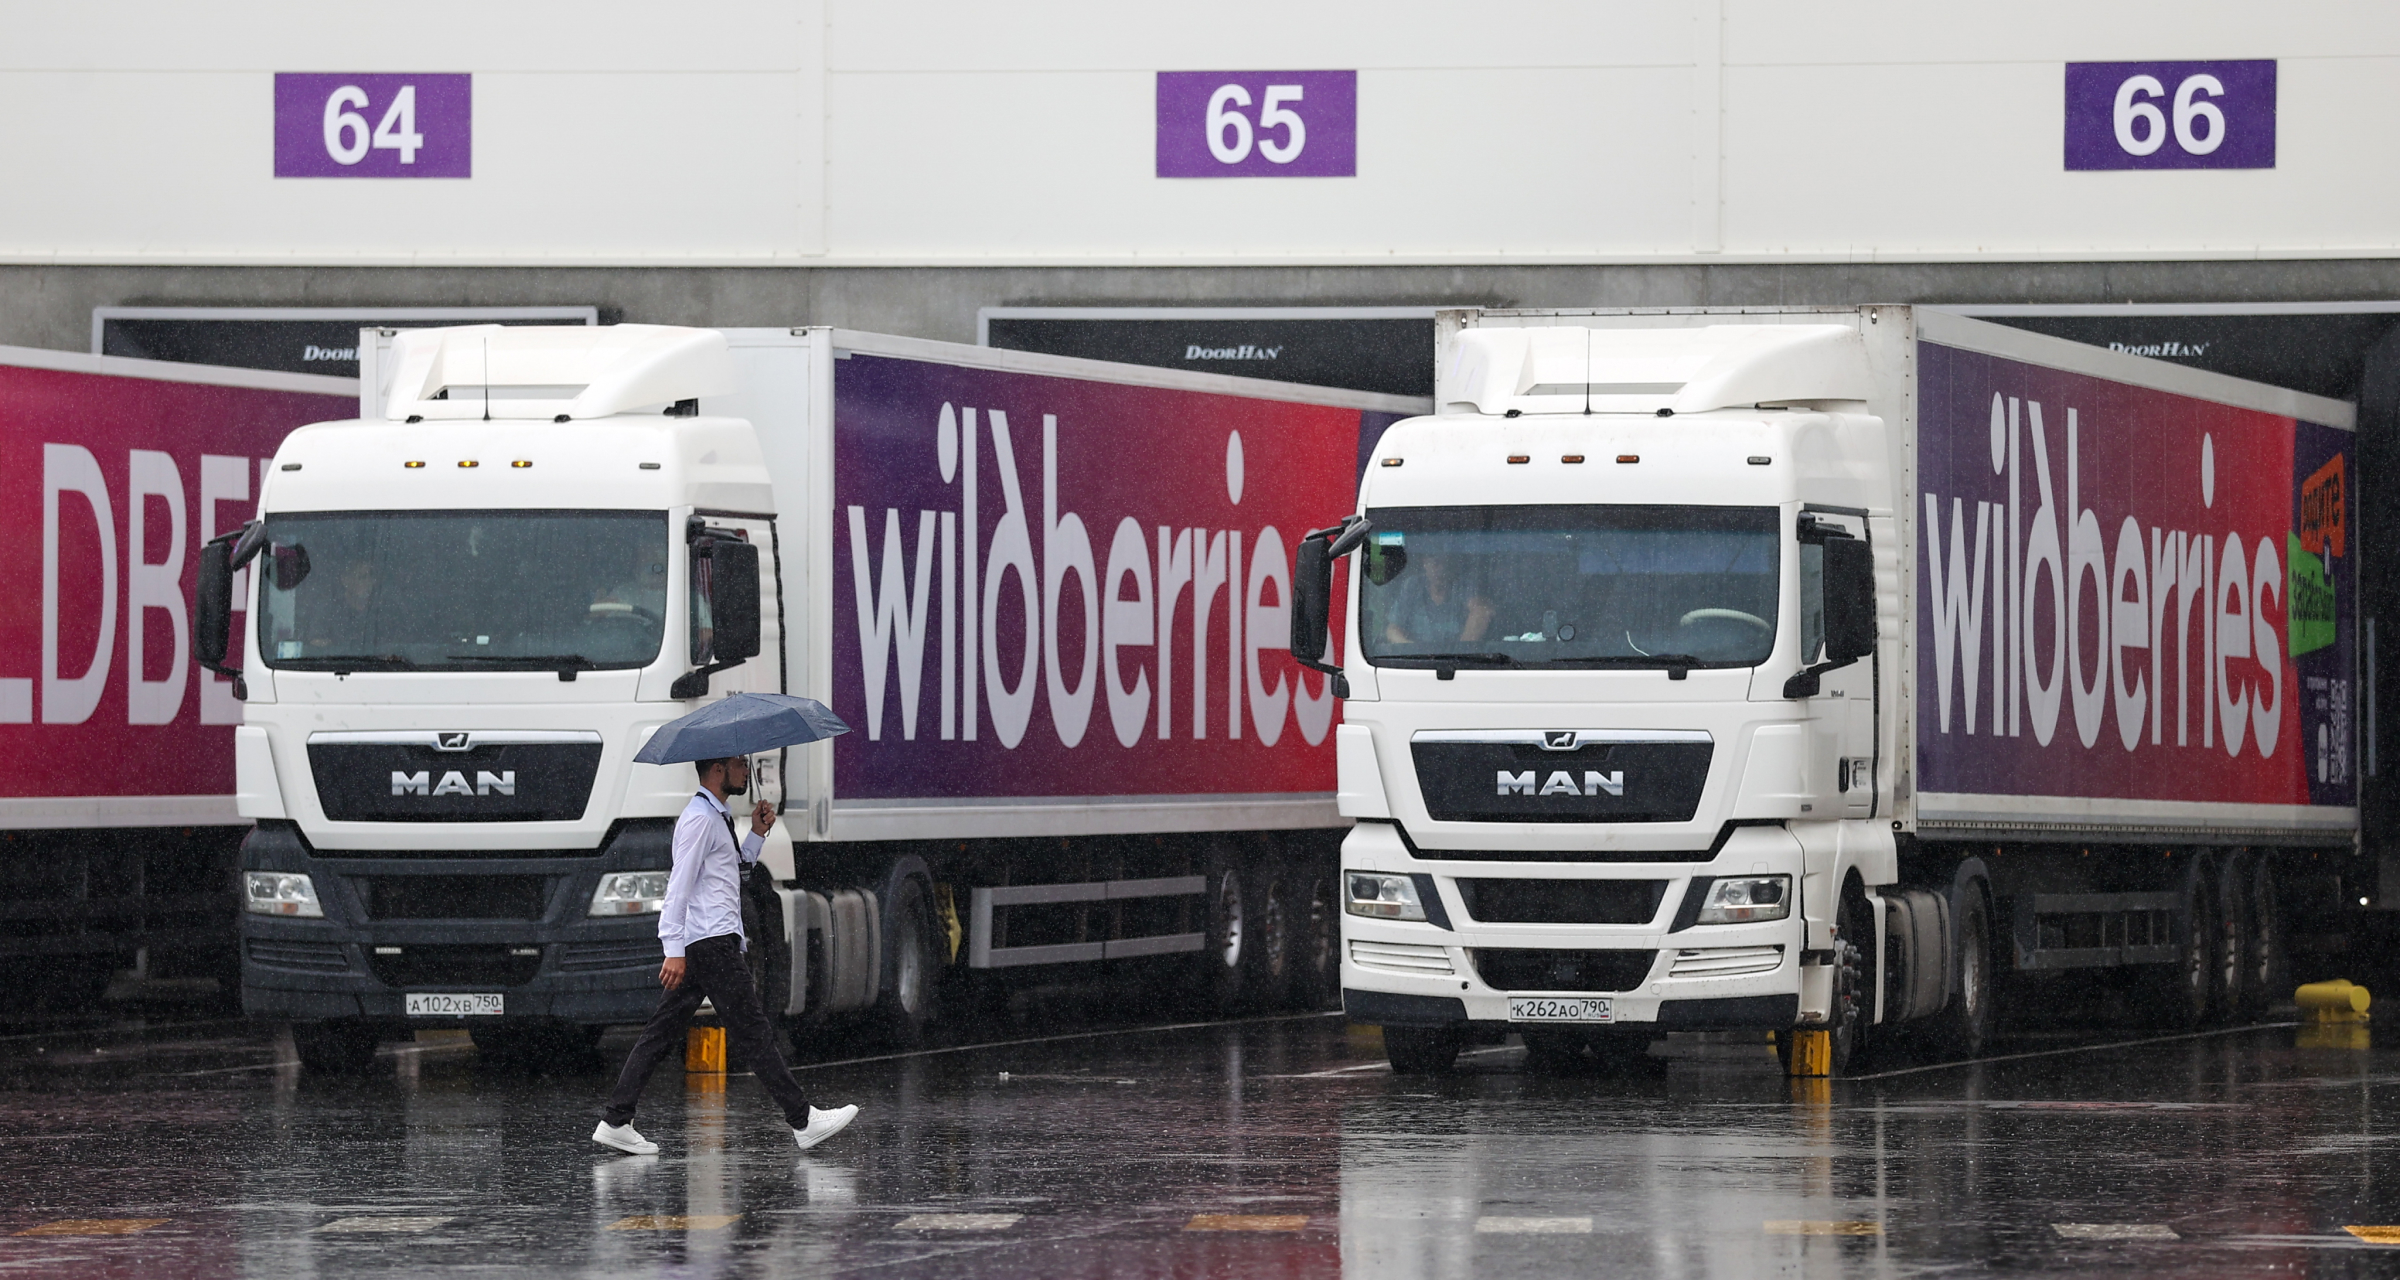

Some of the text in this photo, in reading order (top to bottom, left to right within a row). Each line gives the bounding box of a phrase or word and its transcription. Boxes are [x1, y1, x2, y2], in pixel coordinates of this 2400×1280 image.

[323, 85, 424, 165] 64
[1205, 83, 1306, 164] 65
[2113, 73, 2226, 156] 66
[0, 442, 271, 726] DBE
[1925, 391, 2282, 759] wildberries
[391, 770, 516, 796] MAN
[1496, 770, 1624, 796] MAN
[474, 995, 499, 1008] 750
[1581, 1000, 1606, 1014] 790
